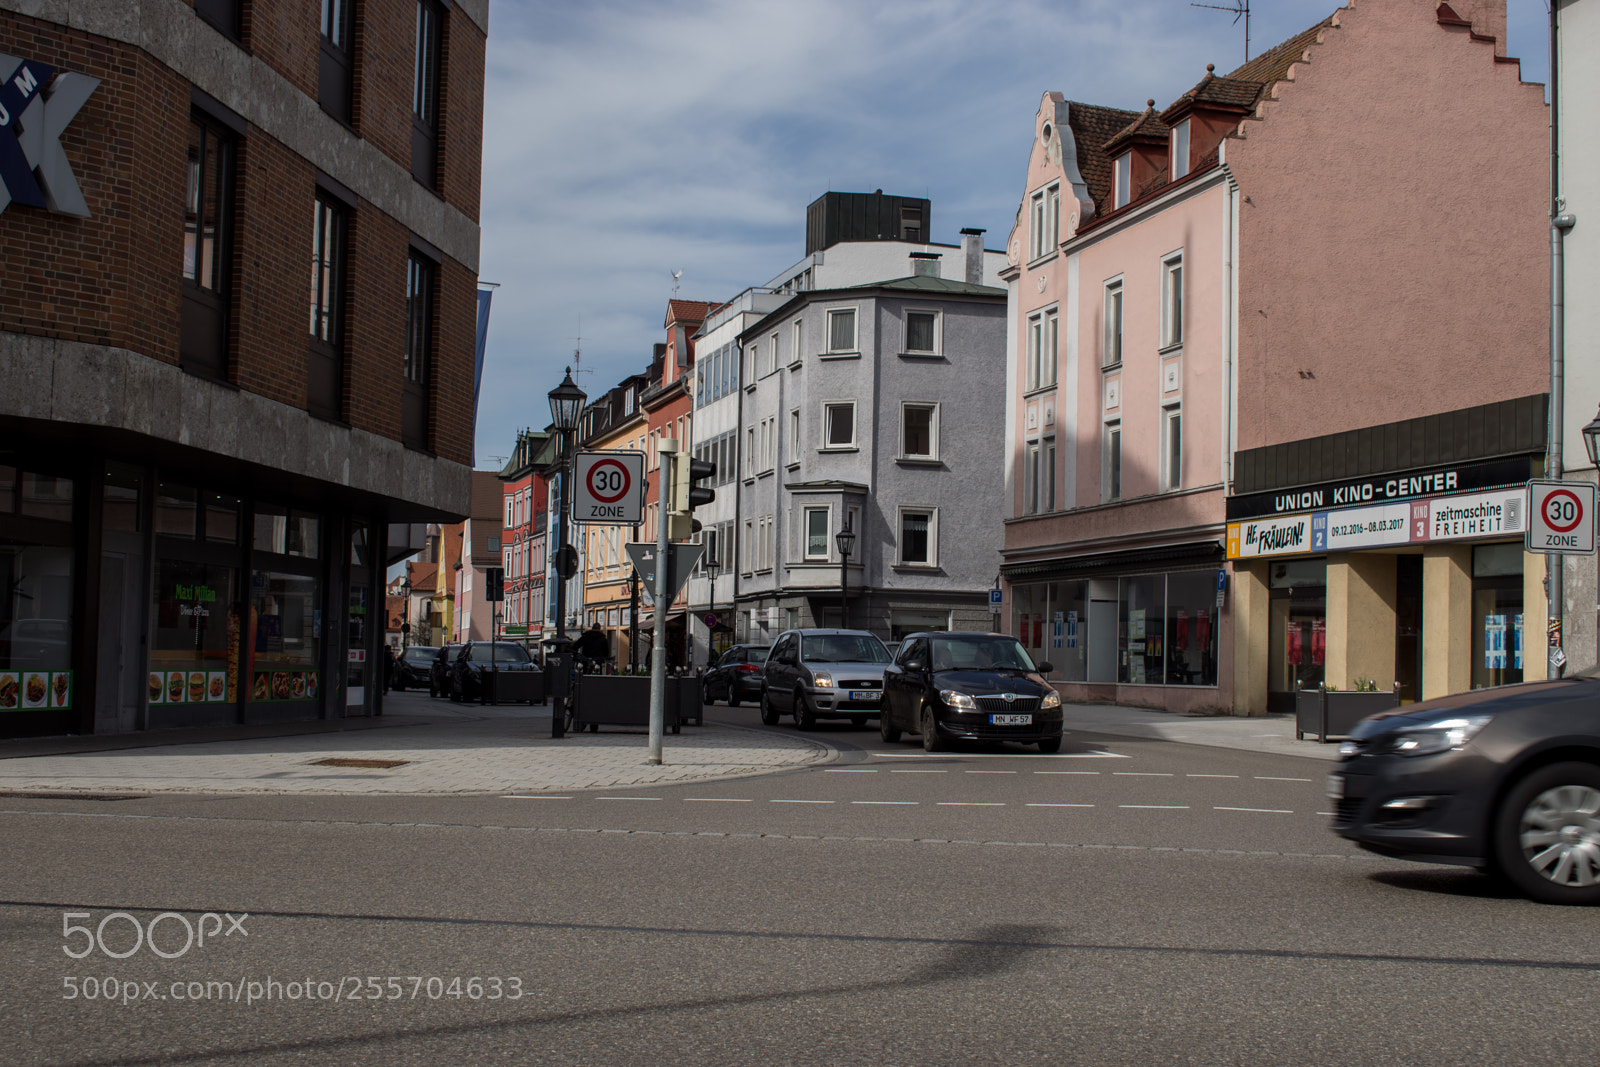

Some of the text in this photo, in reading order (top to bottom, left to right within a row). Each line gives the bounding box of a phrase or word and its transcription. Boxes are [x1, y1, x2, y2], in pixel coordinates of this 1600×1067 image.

[595, 471, 621, 491] 30
[1275, 471, 1458, 512] UNION KINO-CENTER
[590, 505, 625, 518] ZONE
[1413, 505, 1428, 520] KINO
[1435, 501, 1502, 522] zeitmaschine
[1550, 501, 1575, 521] 30
[1416, 521, 1425, 537] 3
[1435, 517, 1502, 537] FREIHEIT
[1246, 521, 1305, 554] HE, FRÄULEIN!
[1315, 532, 1323, 547] 2
[1546, 535, 1578, 547] ZONE
[1231, 541, 1236, 555] 1
[1218, 572, 1225, 588] P
[993, 592, 1001, 602] P
